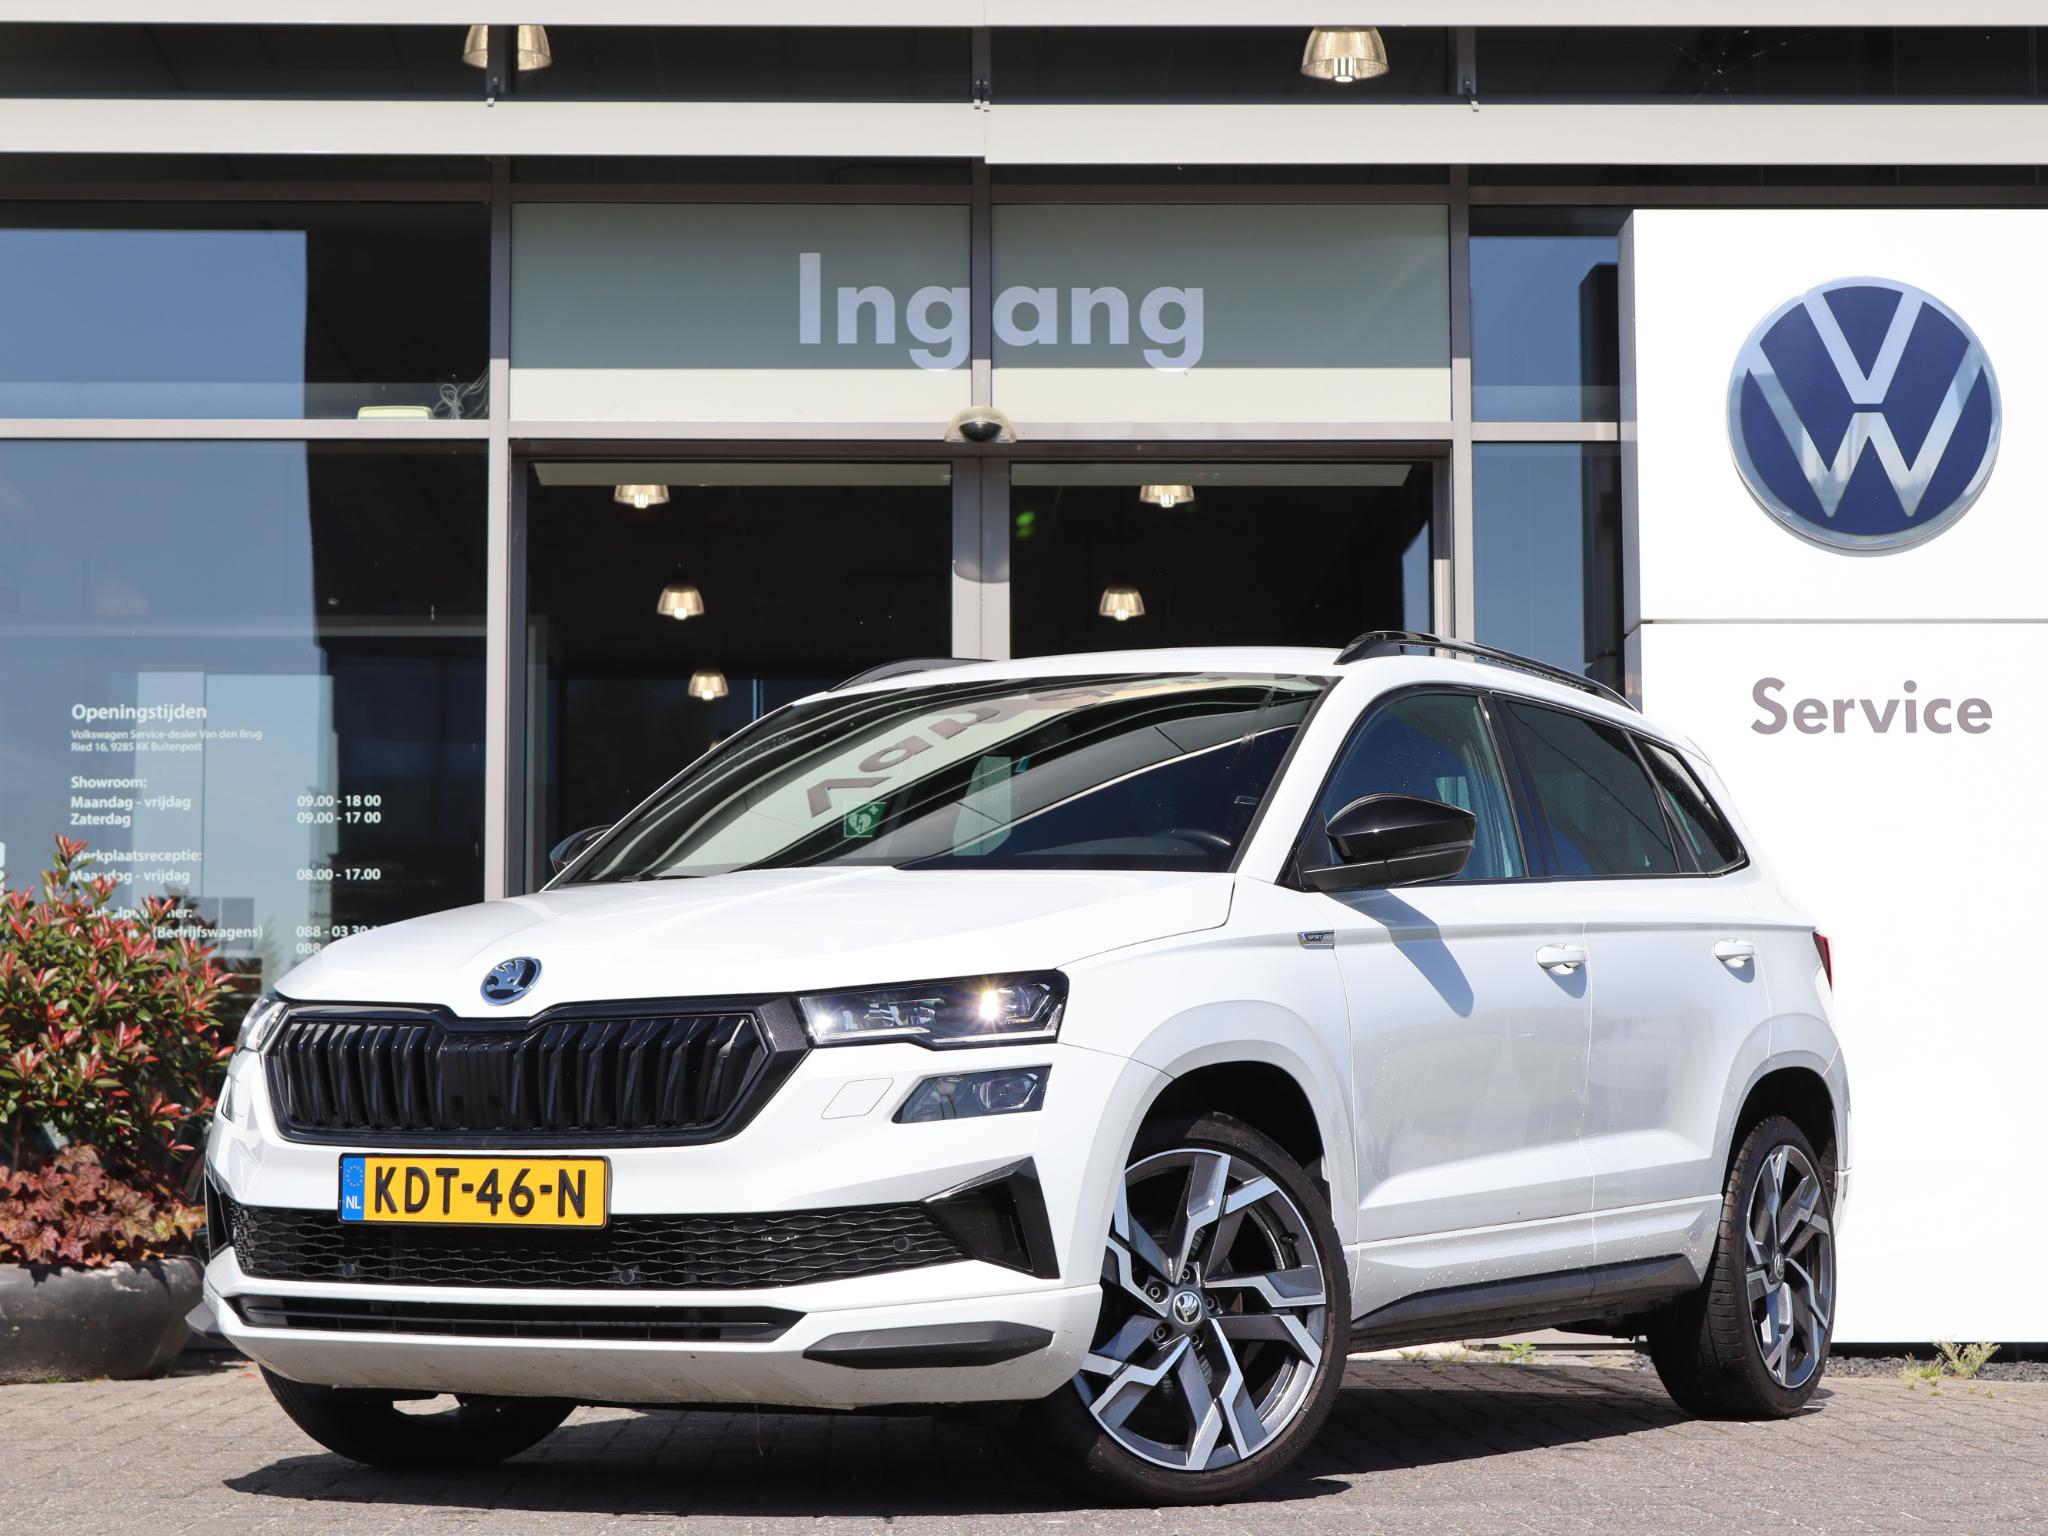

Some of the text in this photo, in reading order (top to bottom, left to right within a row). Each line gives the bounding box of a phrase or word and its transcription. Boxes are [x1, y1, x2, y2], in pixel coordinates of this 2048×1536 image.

[799, 251, 1205, 373] Ingang
[1740, 284, 1988, 518] VW
[1750, 676, 1993, 735] Service
[71, 703, 207, 723] Openingstijden
[70, 729, 262, 741] Volkswagen Service-dealer Van den Brug
[70, 741, 92, 752] Ried
[111, 742, 134, 752] 9285
[136, 741, 150, 751] KK
[151, 741, 203, 752] Buitenpost
[70, 776, 148, 789] Showroom:
[70, 795, 133, 811] Maandag
[144, 795, 191, 811] vrijdag
[296, 795, 334, 807] 09.00
[70, 812, 131, 828] Zaterdag
[296, 811, 334, 823] 09.00
[144, 869, 190, 885] vrijdag
[296, 868, 334, 880] 08.00
[345, 868, 381, 880] 17.00
[153, 926, 263, 940] (Bedrijfswagens)
[296, 925, 321, 938] 088
[331, 925, 349, 938] 03
[296, 942, 321, 954] 088
[374, 1166, 587, 1218] KDT-46-N
[345, 1195, 361, 1210] NL
